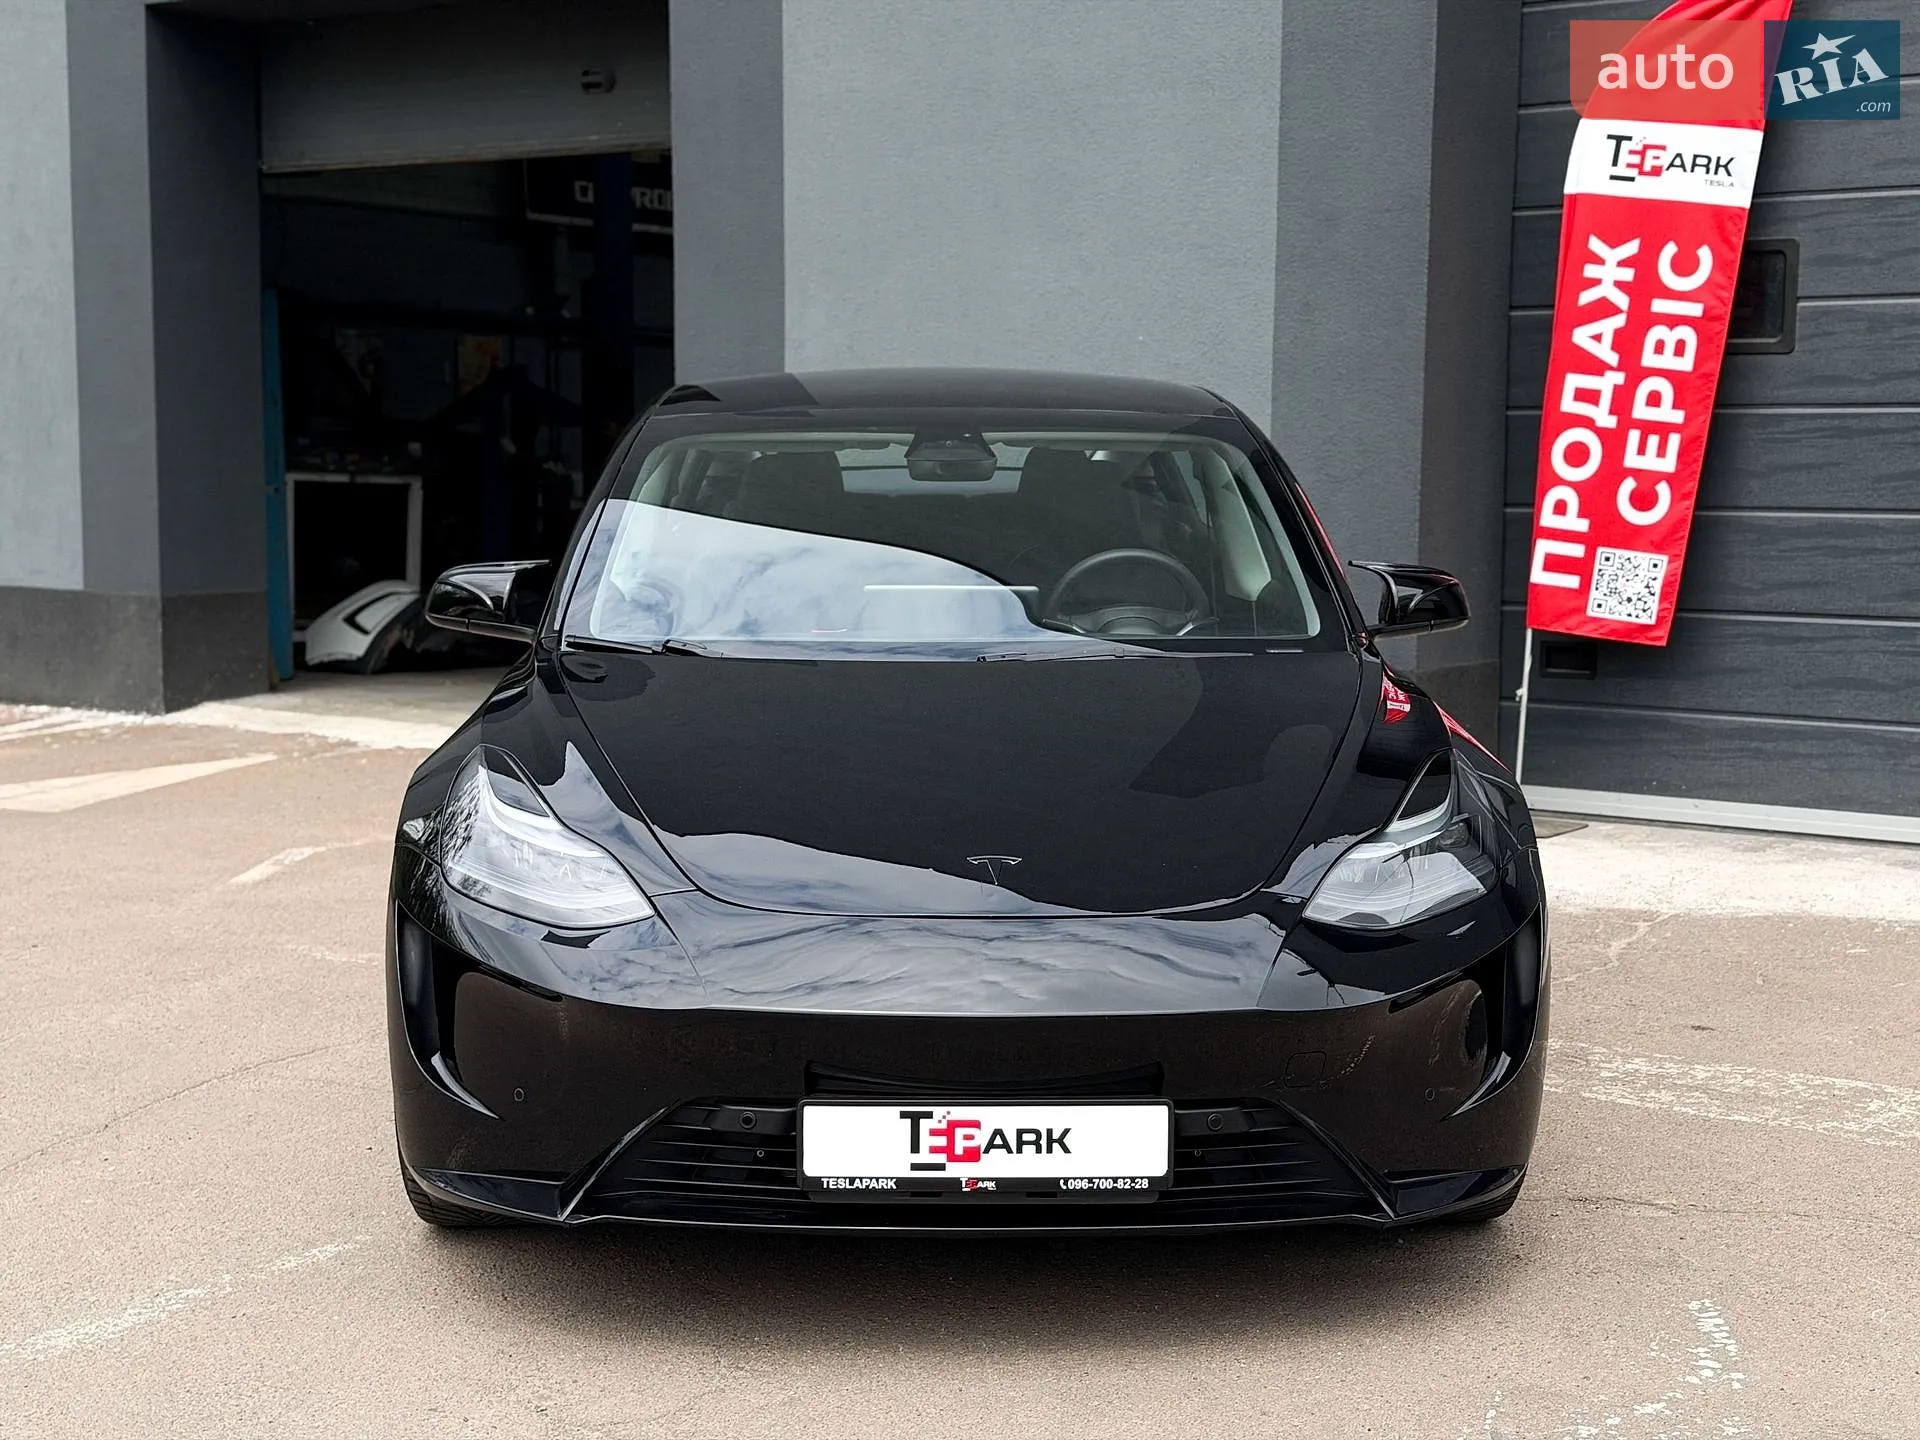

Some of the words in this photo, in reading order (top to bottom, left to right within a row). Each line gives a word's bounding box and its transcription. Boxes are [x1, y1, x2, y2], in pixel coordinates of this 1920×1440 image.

[1529, 234, 1641, 590] ПРОДАЖ
[1616, 239, 1714, 527] СЕРВІС
[820, 1177, 897, 1189] TESLAPARK
[1067, 1178, 1149, 1190] 096-700-82-28
